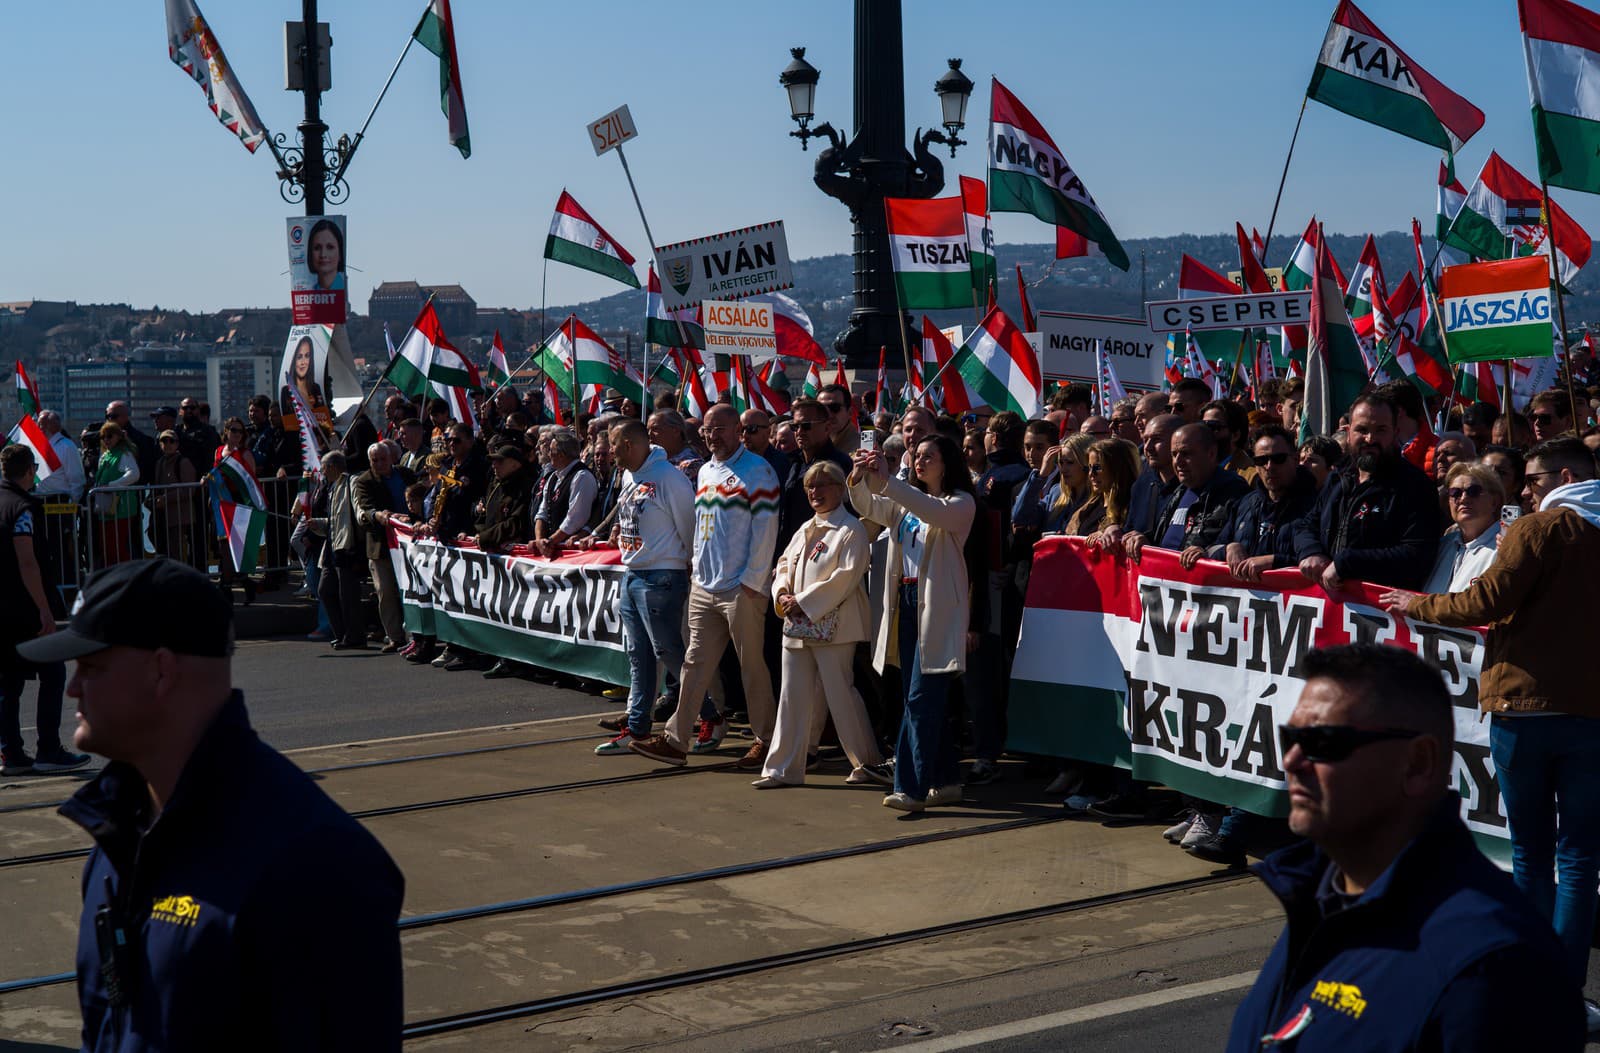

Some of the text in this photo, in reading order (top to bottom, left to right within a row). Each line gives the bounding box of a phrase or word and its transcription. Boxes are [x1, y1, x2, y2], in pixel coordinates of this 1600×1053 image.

[593, 112, 632, 149] SZIL
[995, 134, 1096, 205] NAGYA
[702, 241, 776, 279] IVÁN
[294, 293, 337, 305] HERFORT
[708, 306, 769, 328] ACSALAG
[1163, 299, 1312, 327] CSEPRE
[1447, 292, 1550, 332] JÁSZSÁG
[705, 335, 776, 348] VELETEK VAGYUNK
[1136, 583, 1318, 680] NEM
[1124, 671, 1286, 782] KRÁ
